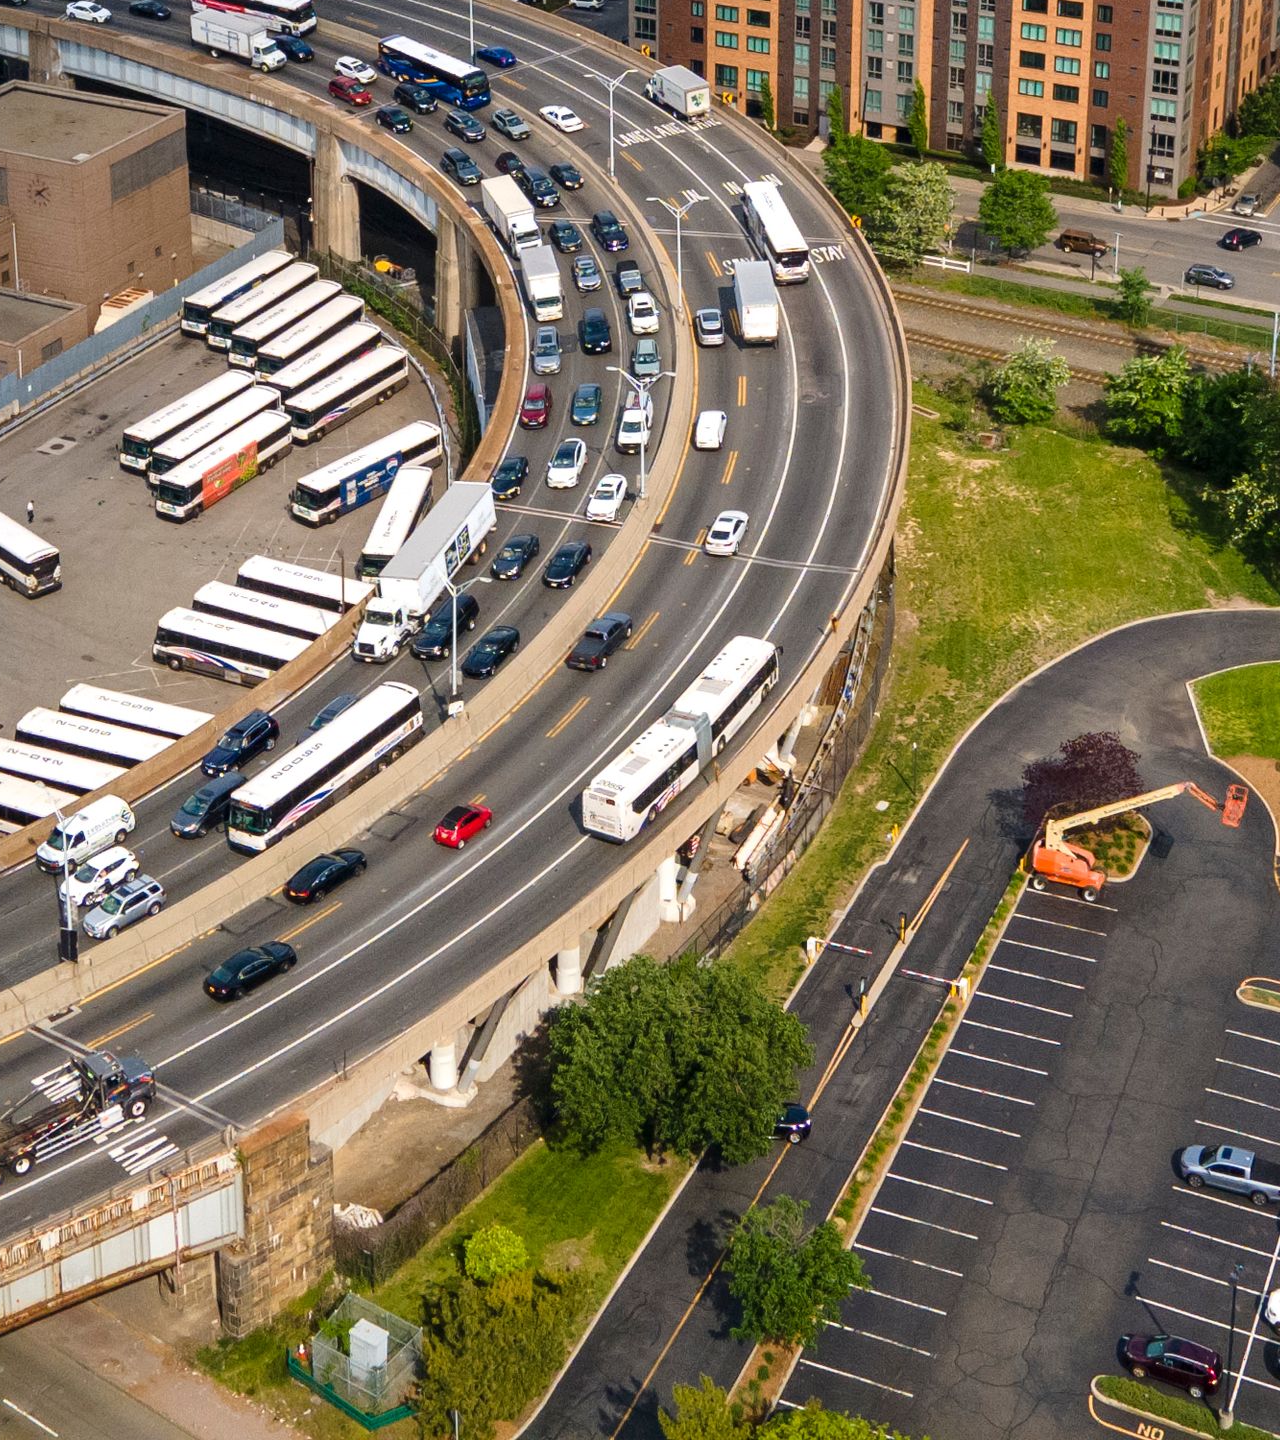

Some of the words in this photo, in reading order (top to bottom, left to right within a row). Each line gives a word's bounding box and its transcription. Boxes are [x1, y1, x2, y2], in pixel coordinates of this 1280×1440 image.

[613, 130, 648, 148] LANE
[648, 122, 686, 140] LANE
[811, 245, 847, 264] STAY
[1136, 1422, 1164, 1440] NO
